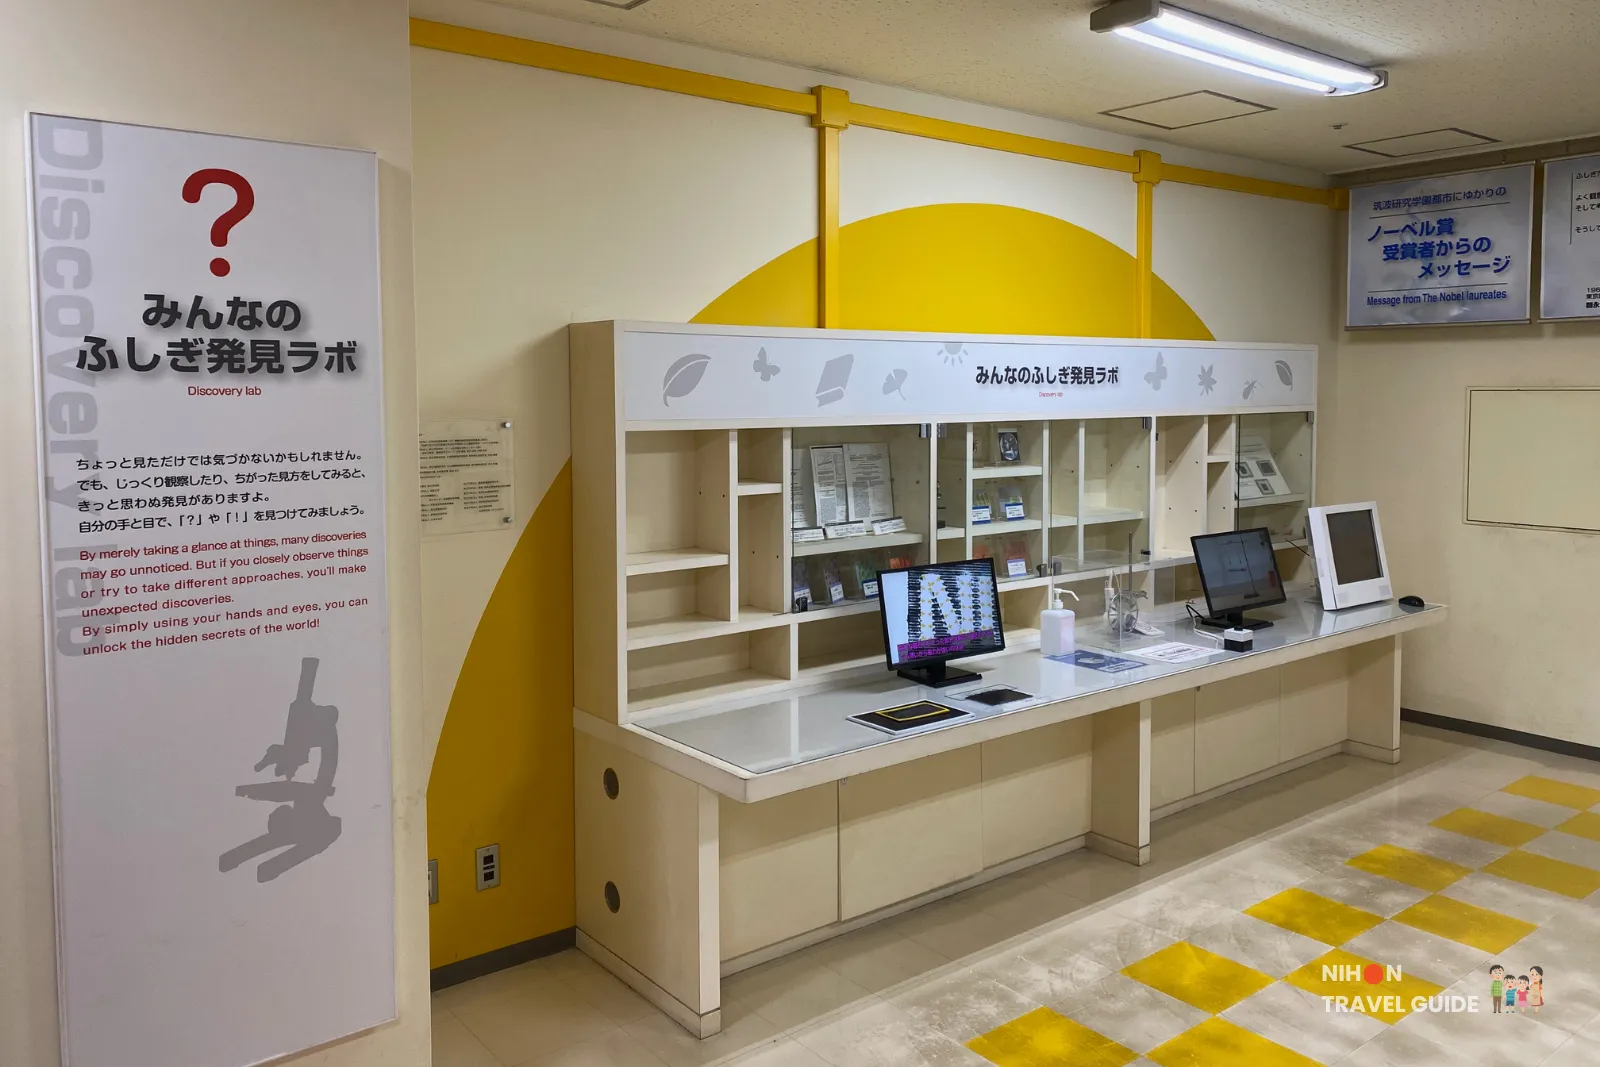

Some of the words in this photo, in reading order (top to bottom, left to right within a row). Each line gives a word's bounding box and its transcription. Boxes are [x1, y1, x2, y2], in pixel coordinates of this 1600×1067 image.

[1373, 186, 1506, 211] 筑波研究学園都市にゆかりの
[1368, 218, 1454, 241] ノーベル賞
[1383, 237, 1491, 261] 受賞者からの
[1418, 256, 1511, 278] メッセージ
[1367, 296, 1400, 306] Message
[1403, 295, 1421, 303] from
[1423, 294, 1437, 302] The
[1440, 292, 1464, 301] Nobel
[1467, 290, 1506, 300] laureates
[37, 117, 105, 517] Discovery
[142, 294, 301, 331] みんなの
[76, 335, 358, 374] ふしぎ発見ラボ
[975, 366, 1119, 385] みんなのふしぎ発見ラボ
[188, 386, 242, 397] Discovery
[246, 386, 262, 396] lab
[76, 451, 362, 470] ちょっと見ただけでは気づかないかもしれません。
[77, 469, 366, 491] でも、じっくり観察したり、ちがった見方をしてみると、
[78, 491, 270, 512] きっと思わぬ発見がありますよ。
[80, 550, 96, 561] By
[99, 547, 140, 558] merely
[144, 545, 179, 556] taking
[182, 545, 188, 553] a
[191, 540, 228, 554] glance
[230, 540, 241, 549] at
[243, 538, 278, 548] things,
[282, 535, 309, 545] many
[312, 530, 367, 543] discoveries
[80, 570, 106, 580] may
[110, 568, 126, 578] go
[130, 561, 191, 575] unnoticed.
[196, 560, 216, 569] But
[219, 559, 227, 568] if
[229, 557, 250, 567] you
[253, 554, 289, 565] closely
[292, 549, 335, 561] observe
[336, 547, 369, 559] things
[80, 590, 95, 598] or
[100, 587, 119, 598] try
[124, 585, 138, 595] to
[142, 583, 170, 593] take
[174, 576, 227, 589] different
[232, 570, 303, 585] approaches,
[307, 567, 335, 578] you'll
[338, 565, 367, 575] make
[82, 600, 157, 618] unexpected
[162, 595, 234, 609] discoveries.
[82, 626, 100, 638] By
[104, 621, 148, 636] simply
[153, 617, 189, 630] using
[192, 613, 220, 626] your
[225, 609, 262, 621] hands
[267, 605, 288, 616] and
[292, 603, 321, 614] eyes,
[325, 601, 345, 611] you
[348, 598, 368, 607] can
[83, 641, 128, 655] unlock
[131, 639, 151, 650] the
[156, 634, 197, 646] hidden
[202, 628, 245, 641] secrets
[249, 625, 260, 635] of
[264, 623, 282, 633] the
[286, 620, 320, 631] world!
